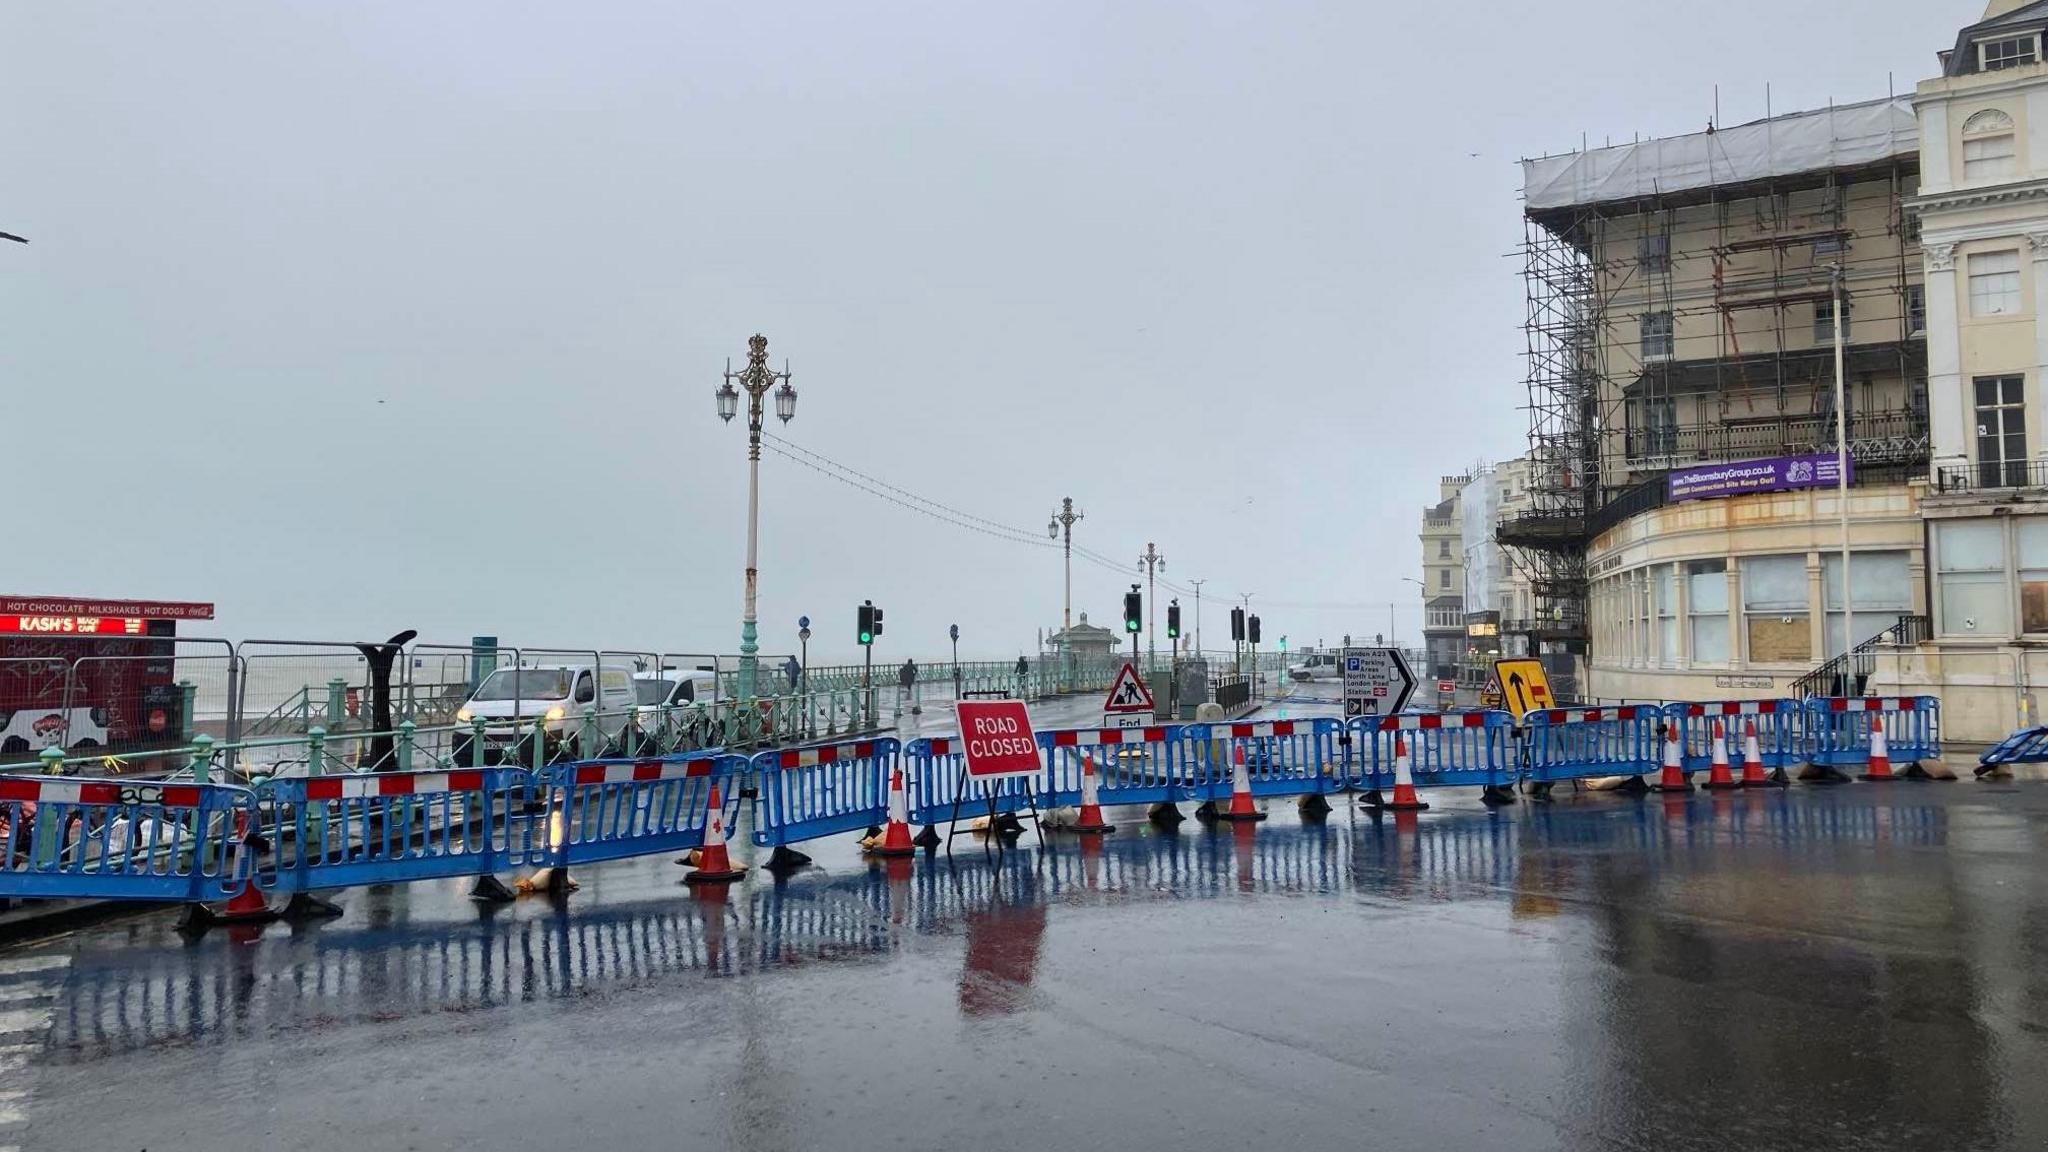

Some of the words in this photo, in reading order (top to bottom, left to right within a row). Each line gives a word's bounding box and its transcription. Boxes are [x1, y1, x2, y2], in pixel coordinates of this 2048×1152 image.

[1673, 464, 1775, 486] www.TheBloomsburyGroup.co.uk
[1740, 479, 1758, 487] Keep
[7, 602, 27, 611] HOT
[29, 603, 84, 613] CHOCOLATE
[88, 605, 140, 614] MILKSHAKES
[162, 607, 184, 615] DOGS
[20, 616, 75, 632] KASH'S
[974, 717, 1018, 734] ROAD
[1119, 718, 1141, 727] End
[971, 738, 1033, 758] CLOSED
